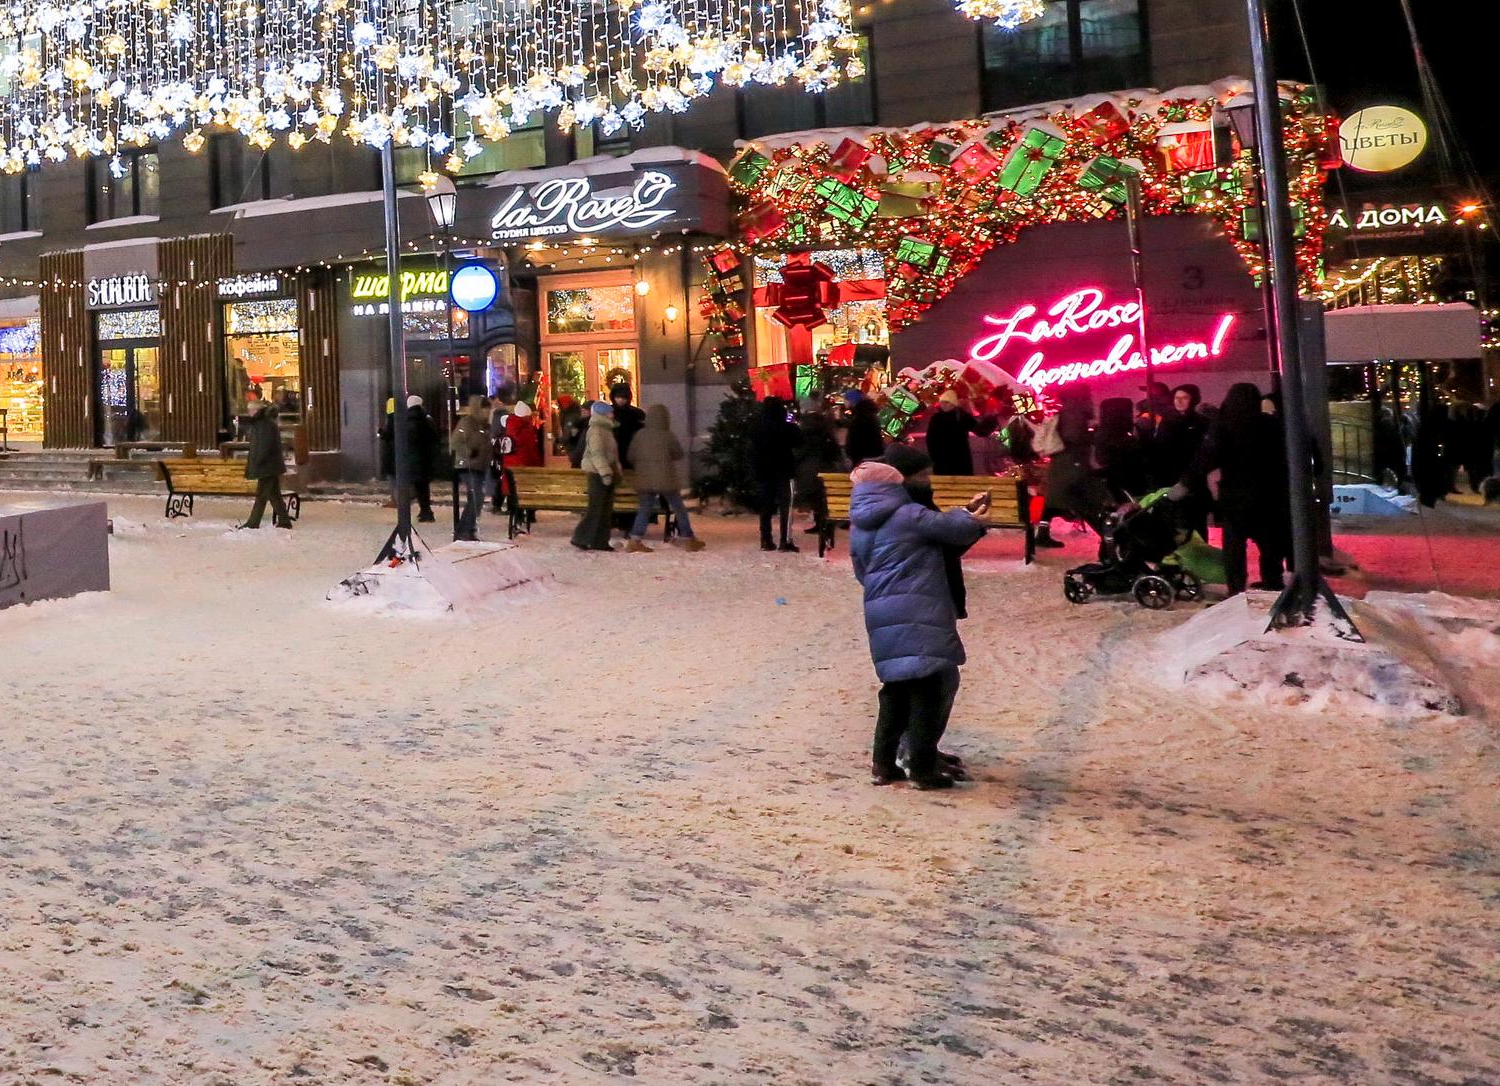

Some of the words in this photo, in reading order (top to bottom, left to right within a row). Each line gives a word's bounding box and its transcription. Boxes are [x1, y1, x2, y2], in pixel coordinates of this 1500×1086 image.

[1344, 132, 1418, 151] ЦВЕТЫ
[1356, 205, 1449, 230] ДОМА
[492, 228, 528, 240] СТУДИЯ
[529, 225, 568, 237] ЦВЕТОВ
[218, 278, 278, 297] кофейня
[353, 270, 449, 303] шарма
[353, 303, 375, 316] НА
[378, 300, 446, 315] ЛНИНА
